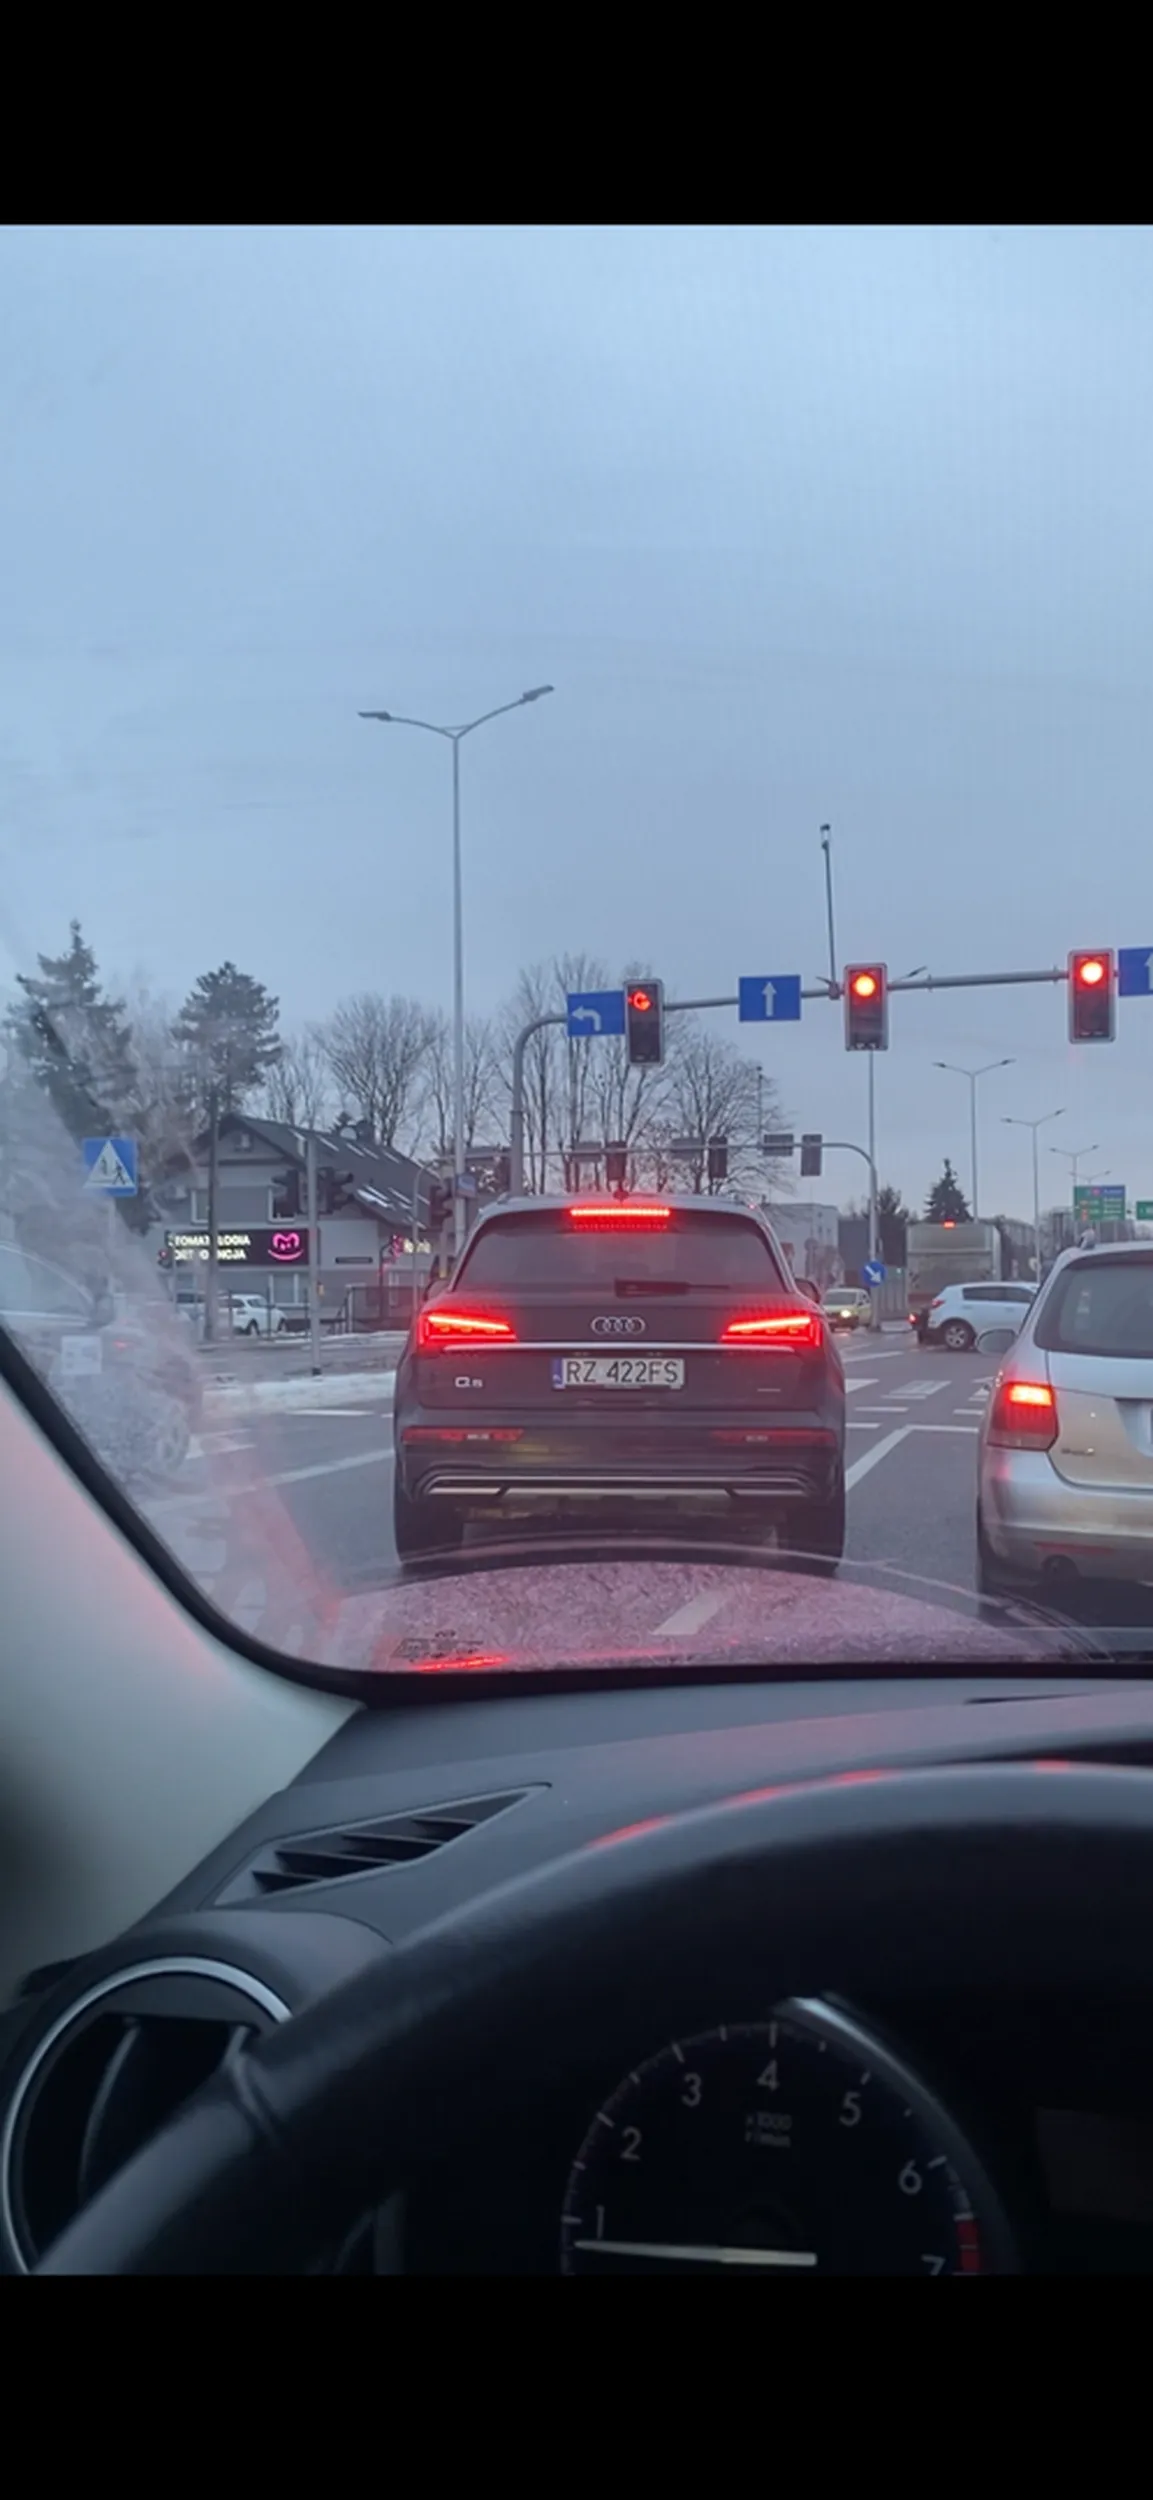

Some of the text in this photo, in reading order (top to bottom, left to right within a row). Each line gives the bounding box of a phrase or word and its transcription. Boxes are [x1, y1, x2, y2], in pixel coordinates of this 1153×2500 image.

[566, 1361, 597, 1383] RZ
[605, 1361, 679, 1383] 422FS
[681, 2073, 702, 2107] 3
[756, 2059, 779, 2091] 4
[839, 2091, 862, 2127] 5
[620, 2126, 643, 2161] 2
[897, 2160, 923, 2195] 6
[596, 2205, 606, 2238] 1
